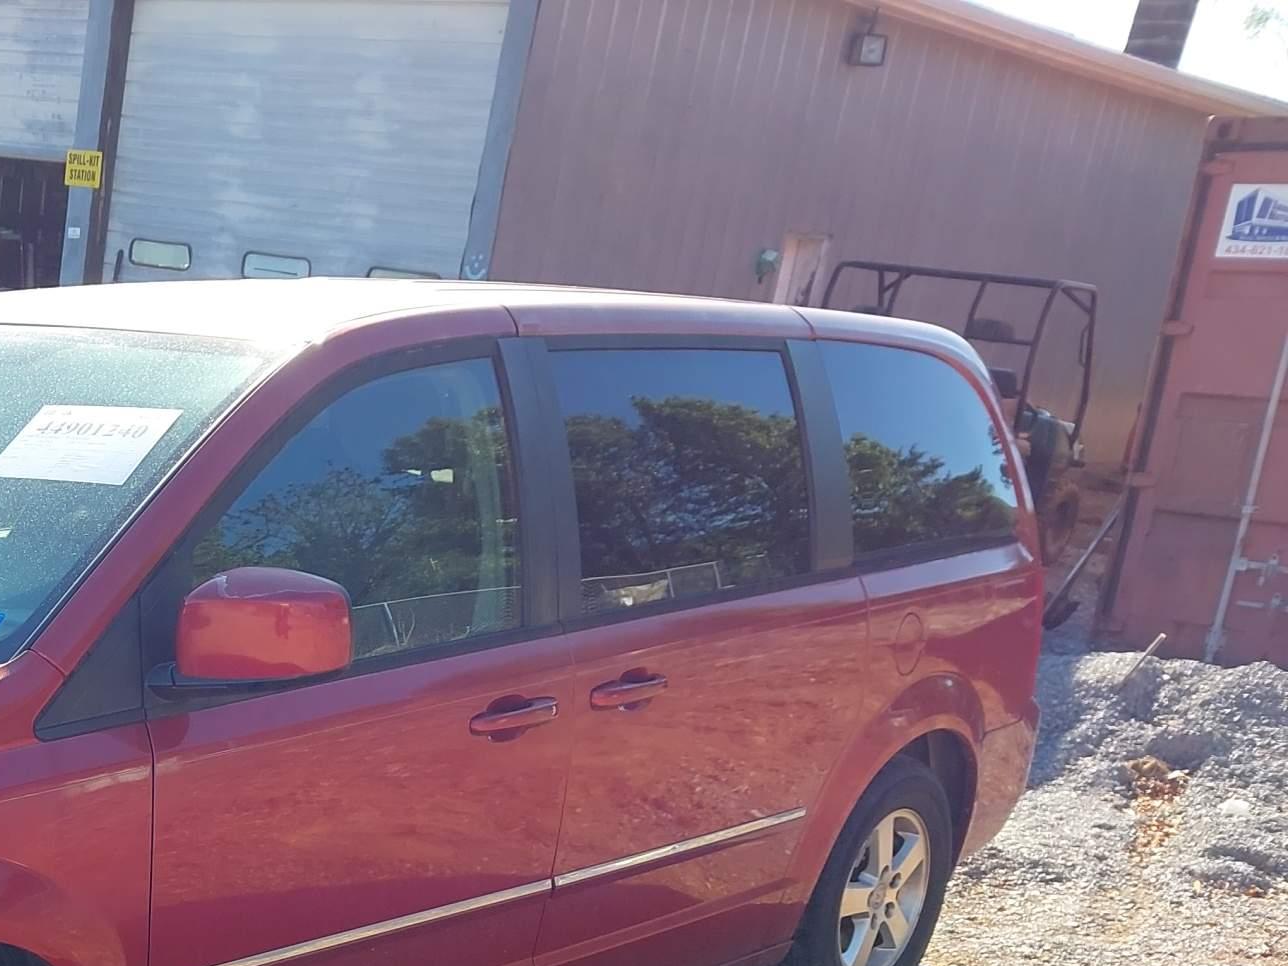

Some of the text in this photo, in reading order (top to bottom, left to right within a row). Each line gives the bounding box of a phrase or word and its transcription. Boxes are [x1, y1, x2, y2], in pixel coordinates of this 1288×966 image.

[68, 152, 101, 167] SPILL-KIT
[69, 168, 97, 182] STATION
[36, 420, 150, 440] 44901240
